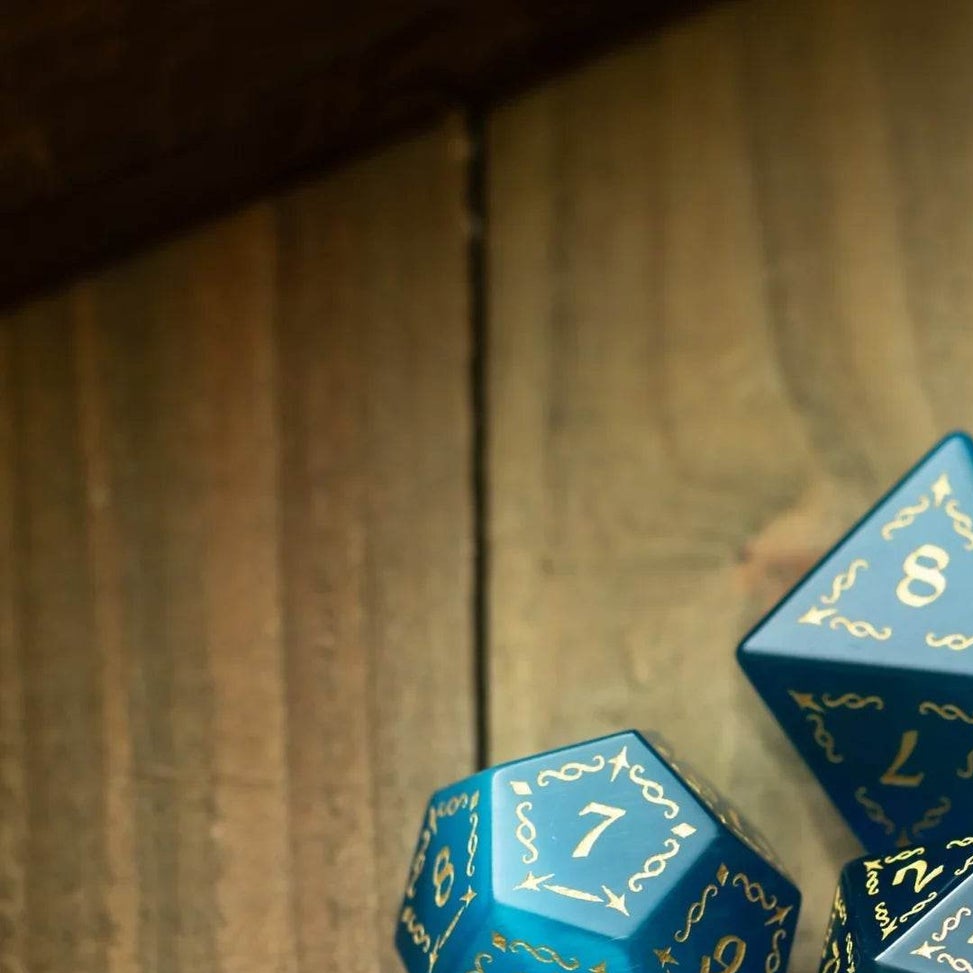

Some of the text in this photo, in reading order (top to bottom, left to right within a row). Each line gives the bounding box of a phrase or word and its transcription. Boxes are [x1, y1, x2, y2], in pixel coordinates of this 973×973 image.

[896, 544, 950, 608] 8
[880, 730, 926, 788] 7
[572, 802, 627, 859] 7
[432, 846, 456, 908] 8
[892, 859, 945, 894] 2
